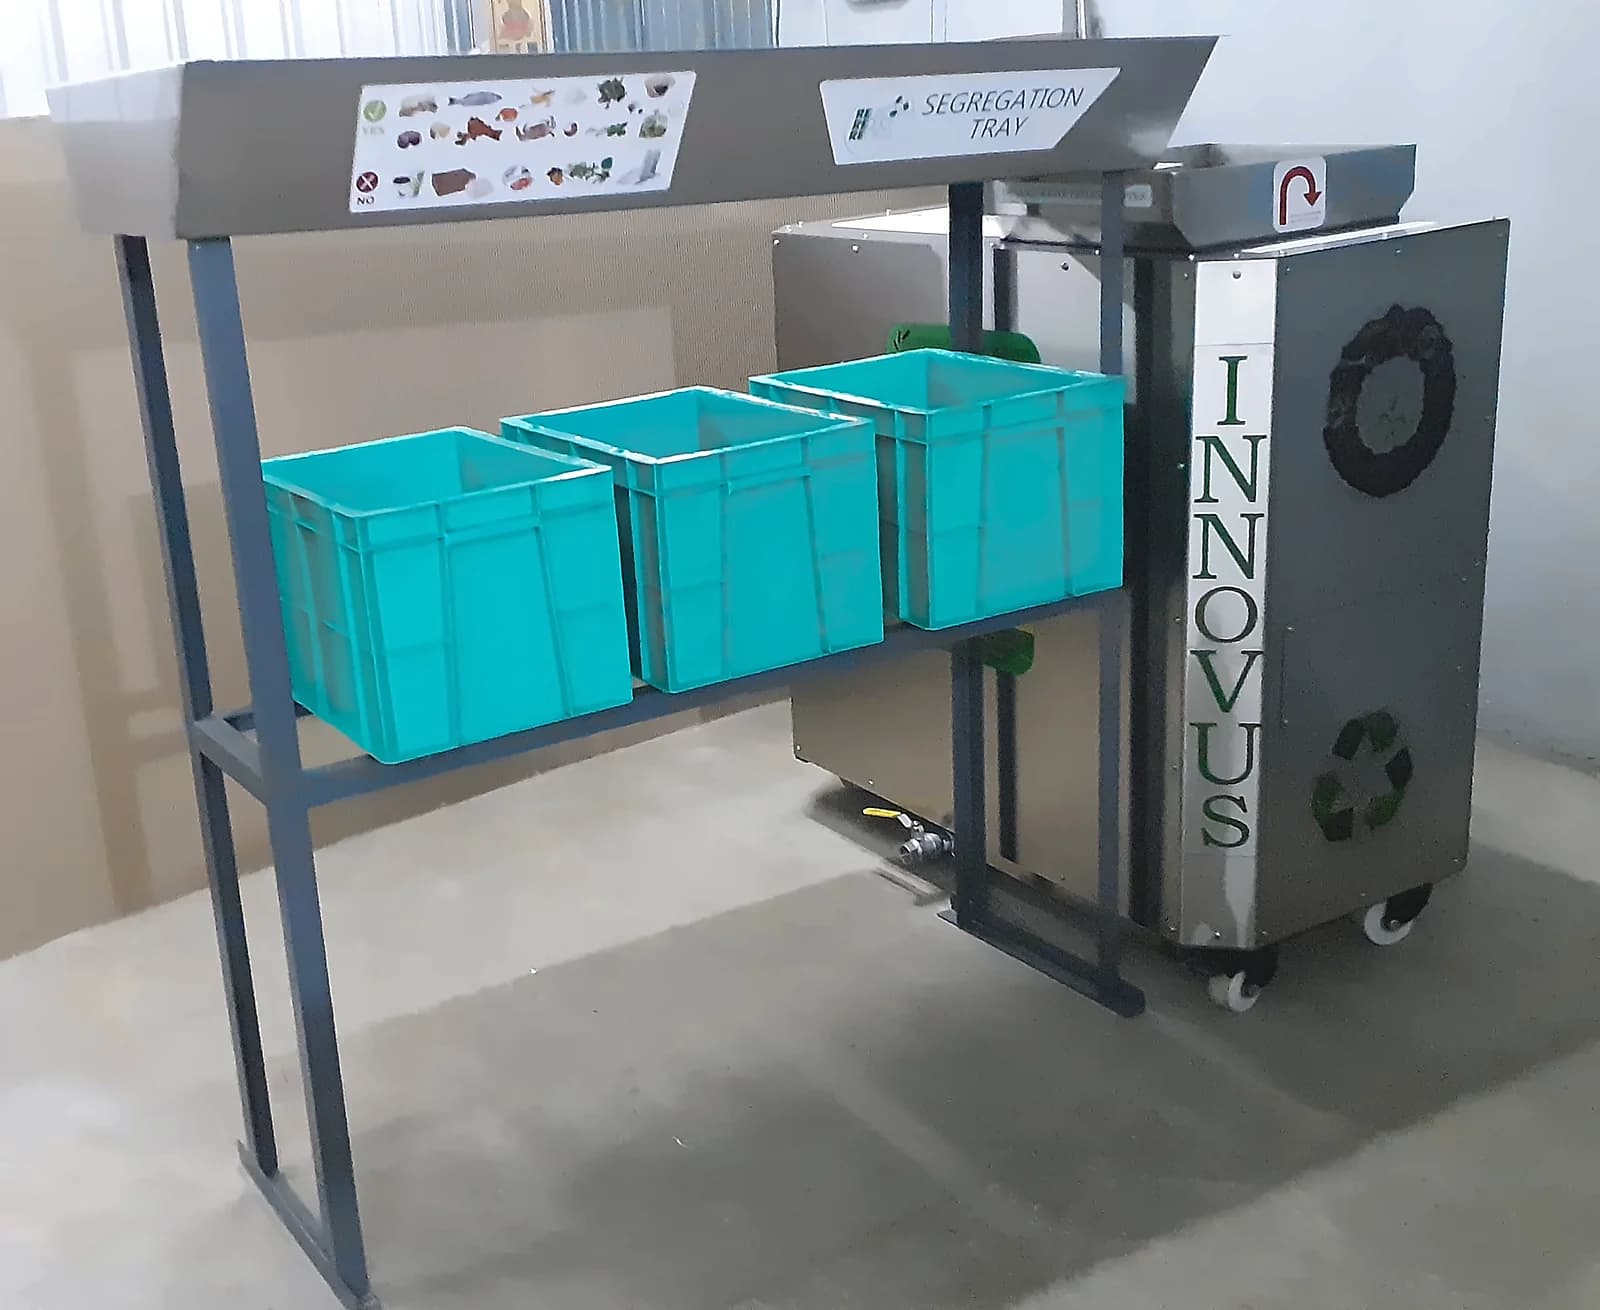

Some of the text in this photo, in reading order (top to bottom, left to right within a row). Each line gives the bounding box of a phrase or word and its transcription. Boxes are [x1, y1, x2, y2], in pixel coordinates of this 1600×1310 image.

[922, 87, 1084, 115] SEGREGATION
[970, 116, 1029, 139] TRAY
[356, 196, 375, 205] NO
[1189, 355, 1267, 848] INNOVUS
